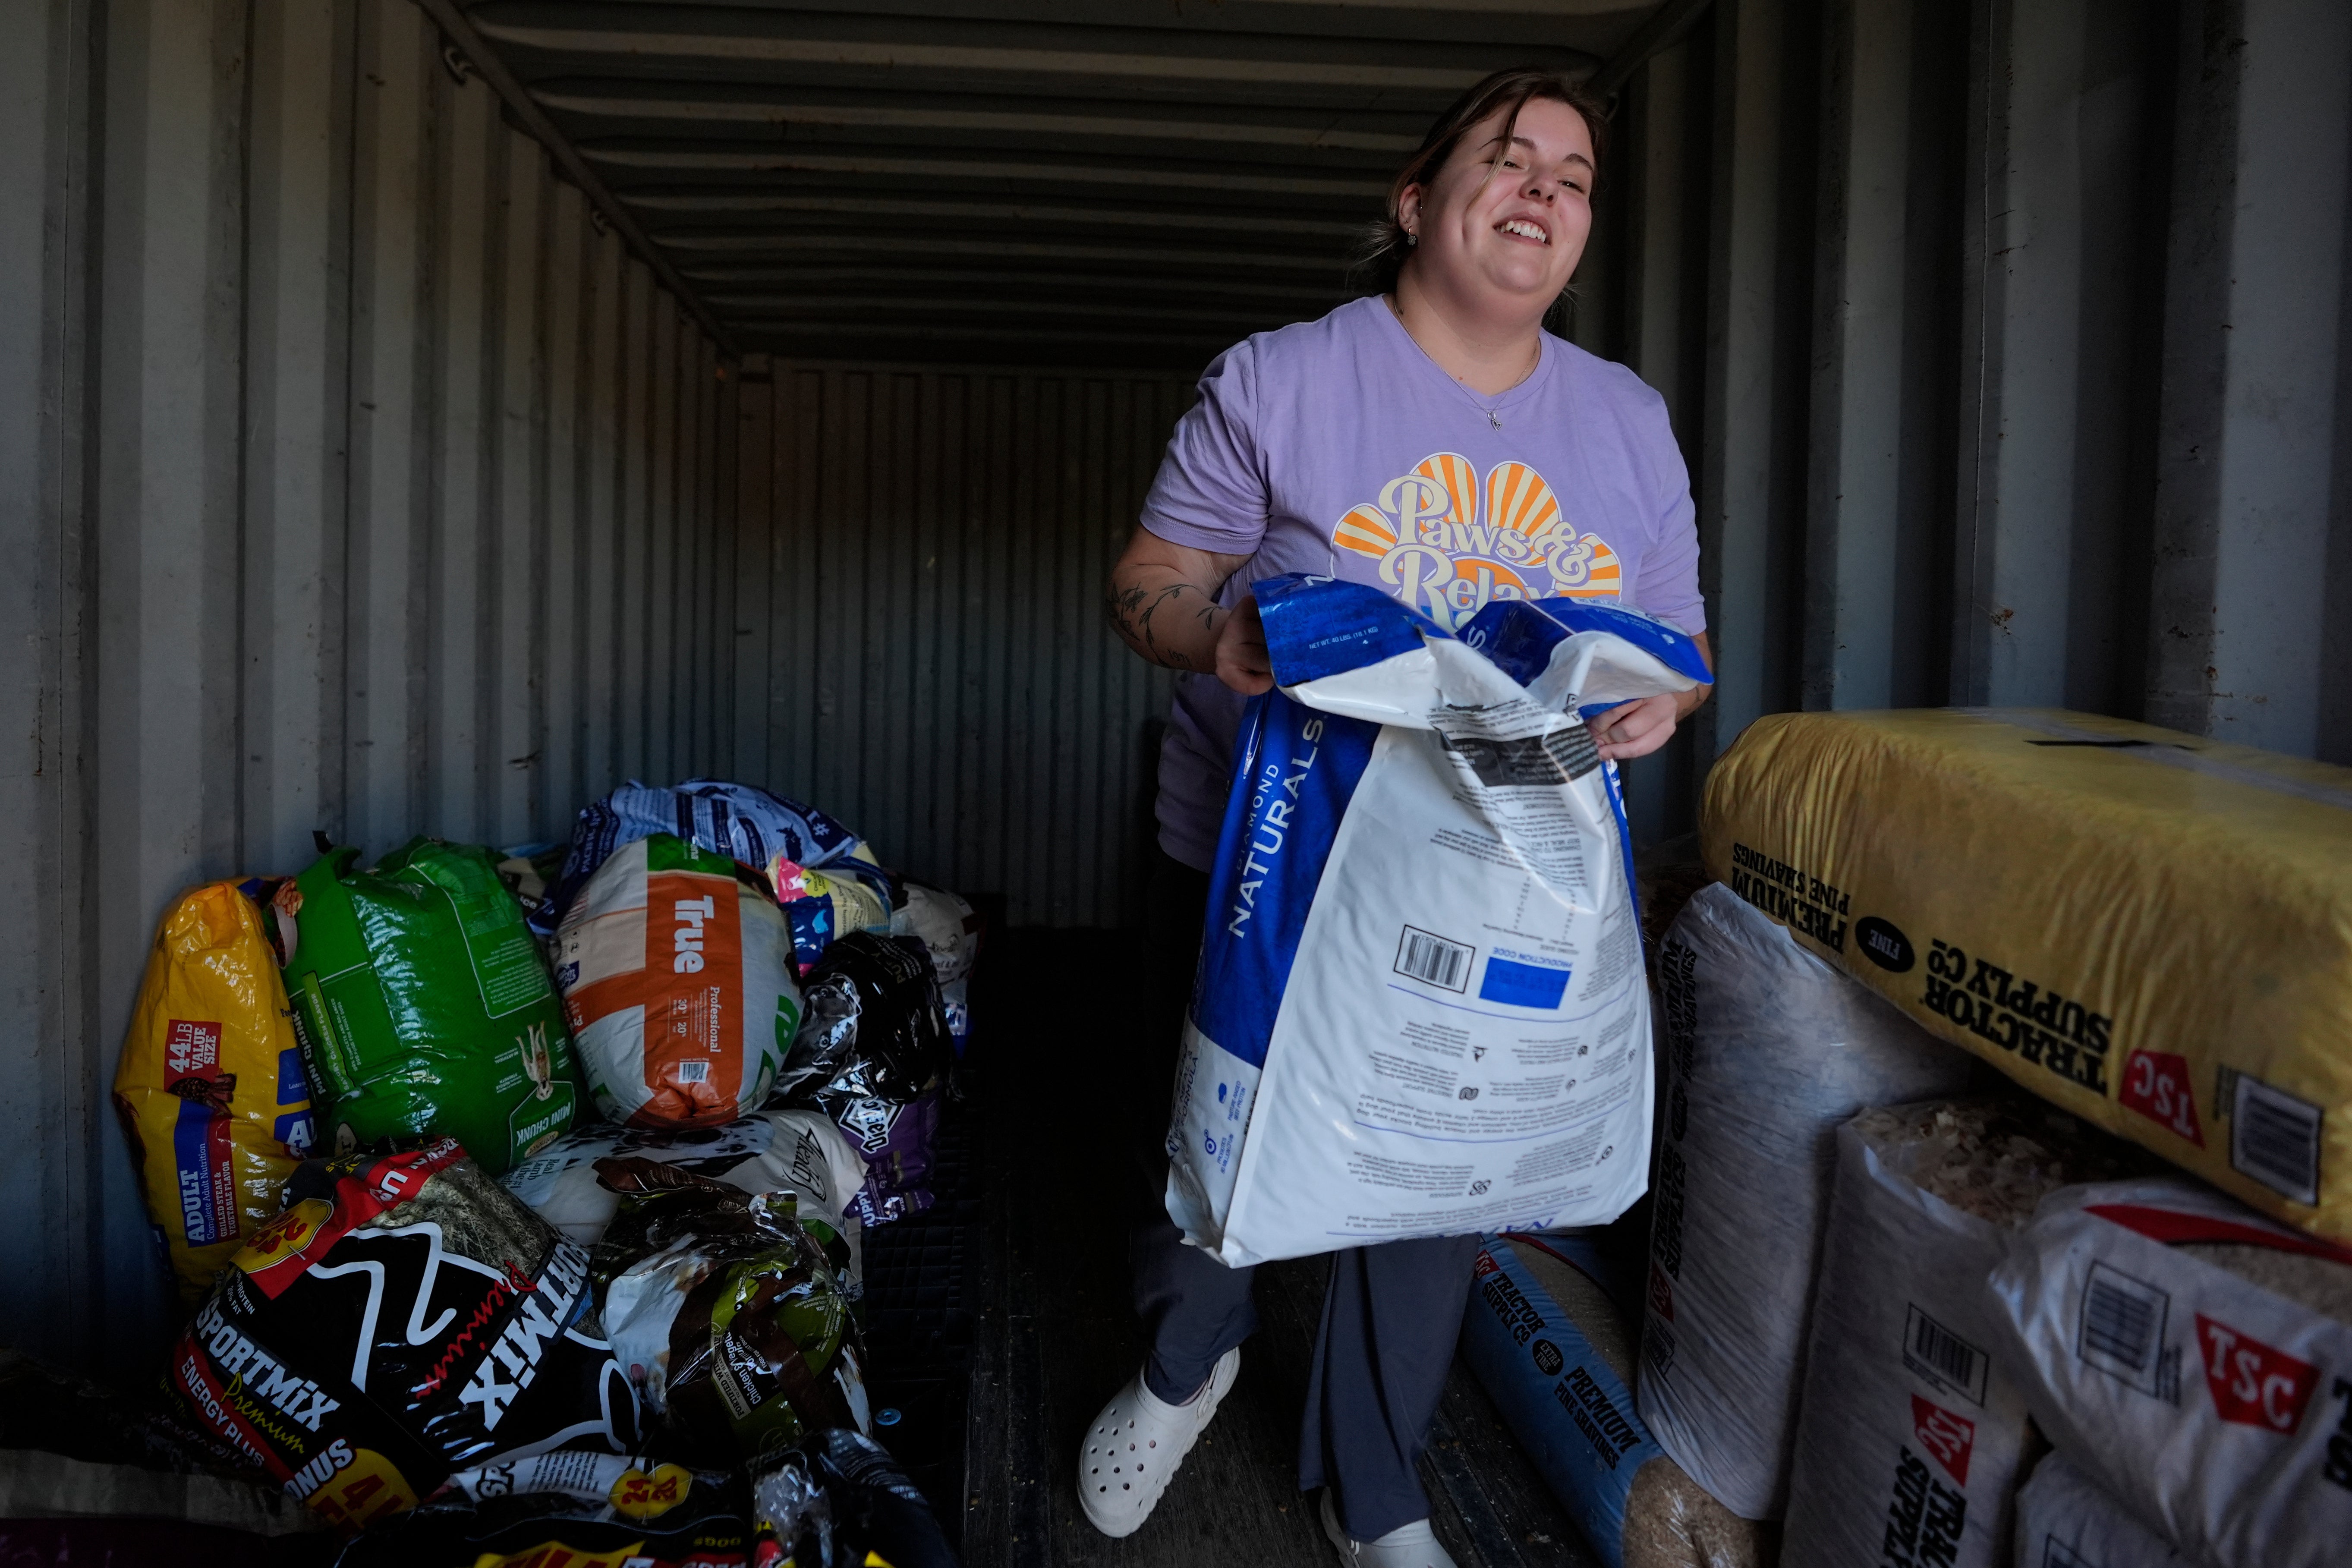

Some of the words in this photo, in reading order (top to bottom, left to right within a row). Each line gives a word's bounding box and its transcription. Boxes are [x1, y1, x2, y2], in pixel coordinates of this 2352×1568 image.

[1379, 475, 1527, 559] Paws
[1533, 521, 1594, 583] &
[1228, 719, 1324, 939] NATURALS
[1732, 841, 1808, 895] SHAVINGS
[1731, 866, 1848, 949] PREMIUM
[1808, 876, 1851, 916] PINE
[674, 895, 715, 973] True
[1493, 946, 1517, 960] CODE
[1869, 928, 1901, 960] FINE
[1519, 952, 1573, 968] PRODUCTION
[310, 993, 324, 1023] FLAVOR
[709, 986, 721, 1053] Professional
[1968, 957, 2112, 1054] SUPPLY
[192, 1027, 206, 1070] VALUE
[204, 1035, 216, 1064] SIZE
[292, 1011, 312, 1061] CHUNK
[1924, 973, 2110, 1098] TRACTOR
[308, 1064, 326, 1095] MINI
[1181, 1058, 1198, 1125] FORMULA
[2133, 1055, 2195, 1135] TSC
[516, 1117, 548, 1146] CHUNK
[551, 1102, 570, 1125] MINI
[199, 1143, 209, 1178] Nutrition
[222, 1161, 232, 1190] FLAVOR
[180, 1170, 205, 1242] ADULT
[201, 1180, 211, 1202] Adult
[215, 1179, 224, 1204] STEAK
[861, 1190, 874, 1226] UPPY
[202, 1203, 216, 1239] Complete
[217, 1206, 227, 1237] GRILLED
[225, 1191, 236, 1235] VEGETABLE
[231, 1299, 241, 1315] FAT
[237, 1283, 255, 1315] PROTEIN
[1482, 1281, 1519, 1331] SUPPLY
[1492, 1272, 1546, 1334] TRACTOR
[417, 1260, 538, 1399] Premium
[736, 1341, 756, 1372] Formula
[1536, 1353, 1552, 1372] FINE
[1540, 1342, 1561, 1366] EXTRA
[724, 1372, 738, 1392] SUPPORT
[739, 1369, 762, 1405] Chicken
[2207, 1326, 2294, 1428] TSC
[180, 1355, 224, 1426] ENERGY
[224, 1422, 265, 1466] PLUS
[221, 1373, 305, 1454] Premium
[721, 1380, 744, 1417] FORTIFIED
[1564, 1366, 1642, 1454] PREMIUM
[1554, 1382, 1574, 1415] PINE
[1574, 1407, 1620, 1470] SHAVINGS
[1917, 1408, 1971, 1464] TSC
[283, 1439, 353, 1500] ONUS
